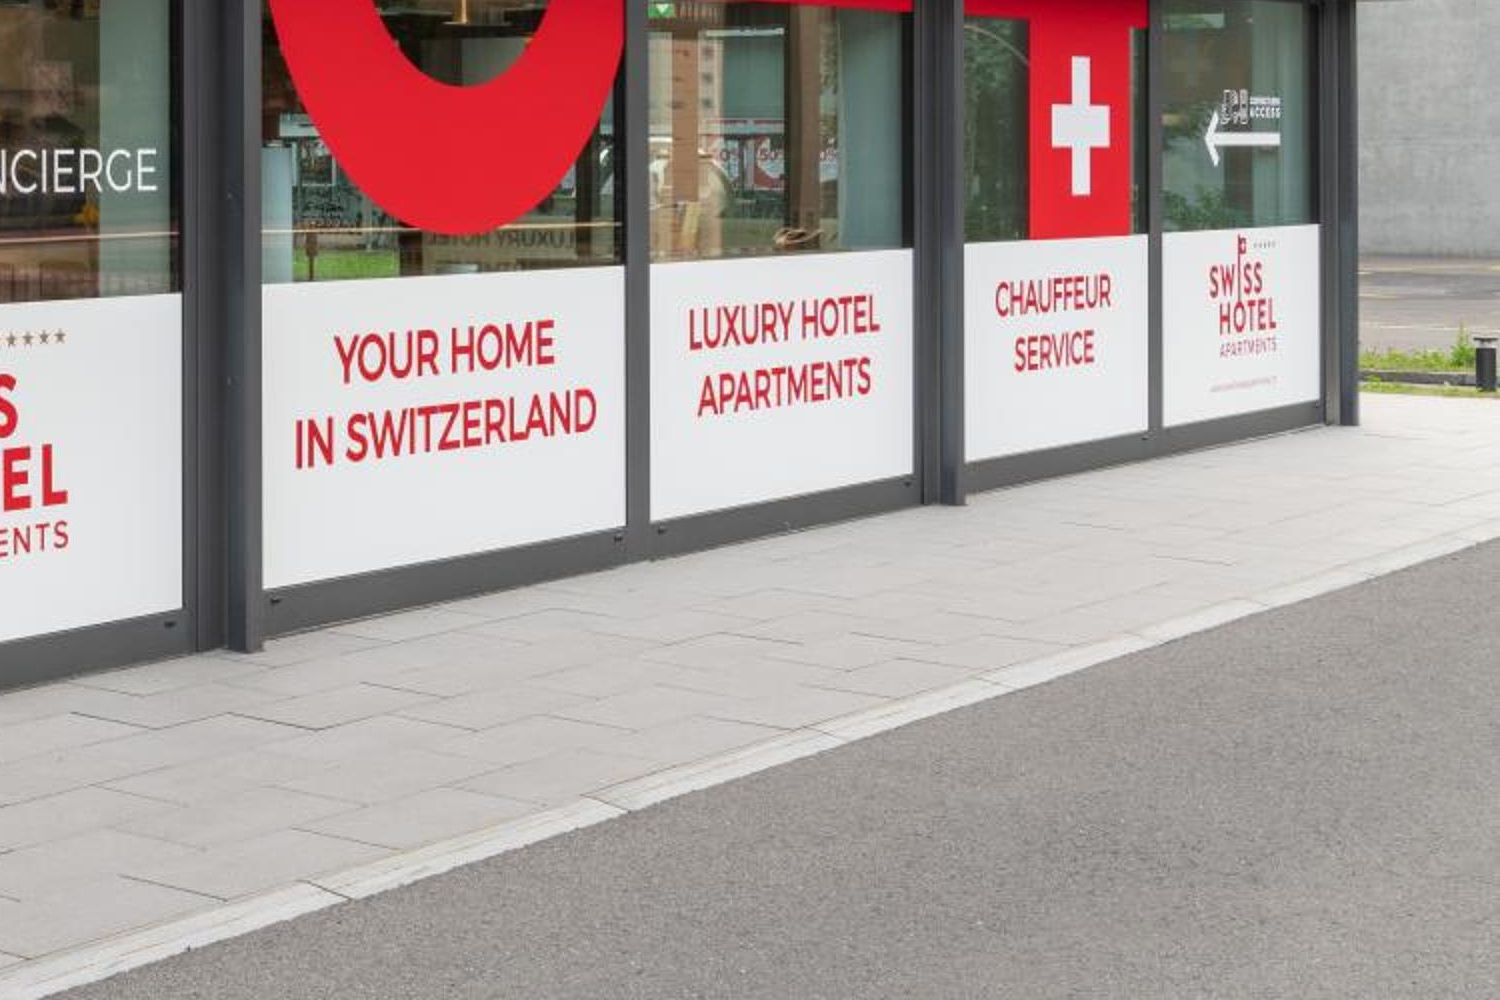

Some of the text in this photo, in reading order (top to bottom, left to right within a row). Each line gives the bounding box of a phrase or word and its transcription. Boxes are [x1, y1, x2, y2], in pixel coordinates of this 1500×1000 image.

[1209, 234, 1263, 299] SWISS
[688, 294, 881, 351] LUXURY HOTEL
[994, 273, 1112, 318] CHAUFFEUR
[1219, 297, 1277, 335] HOTEL
[333, 319, 555, 385] YOUR HOME
[1014, 329, 1095, 373] SERVICE
[1219, 336, 1277, 358] APARTMENTS
[697, 356, 872, 417] APARTMENTS
[295, 388, 597, 470] IN SWITZERLAND
